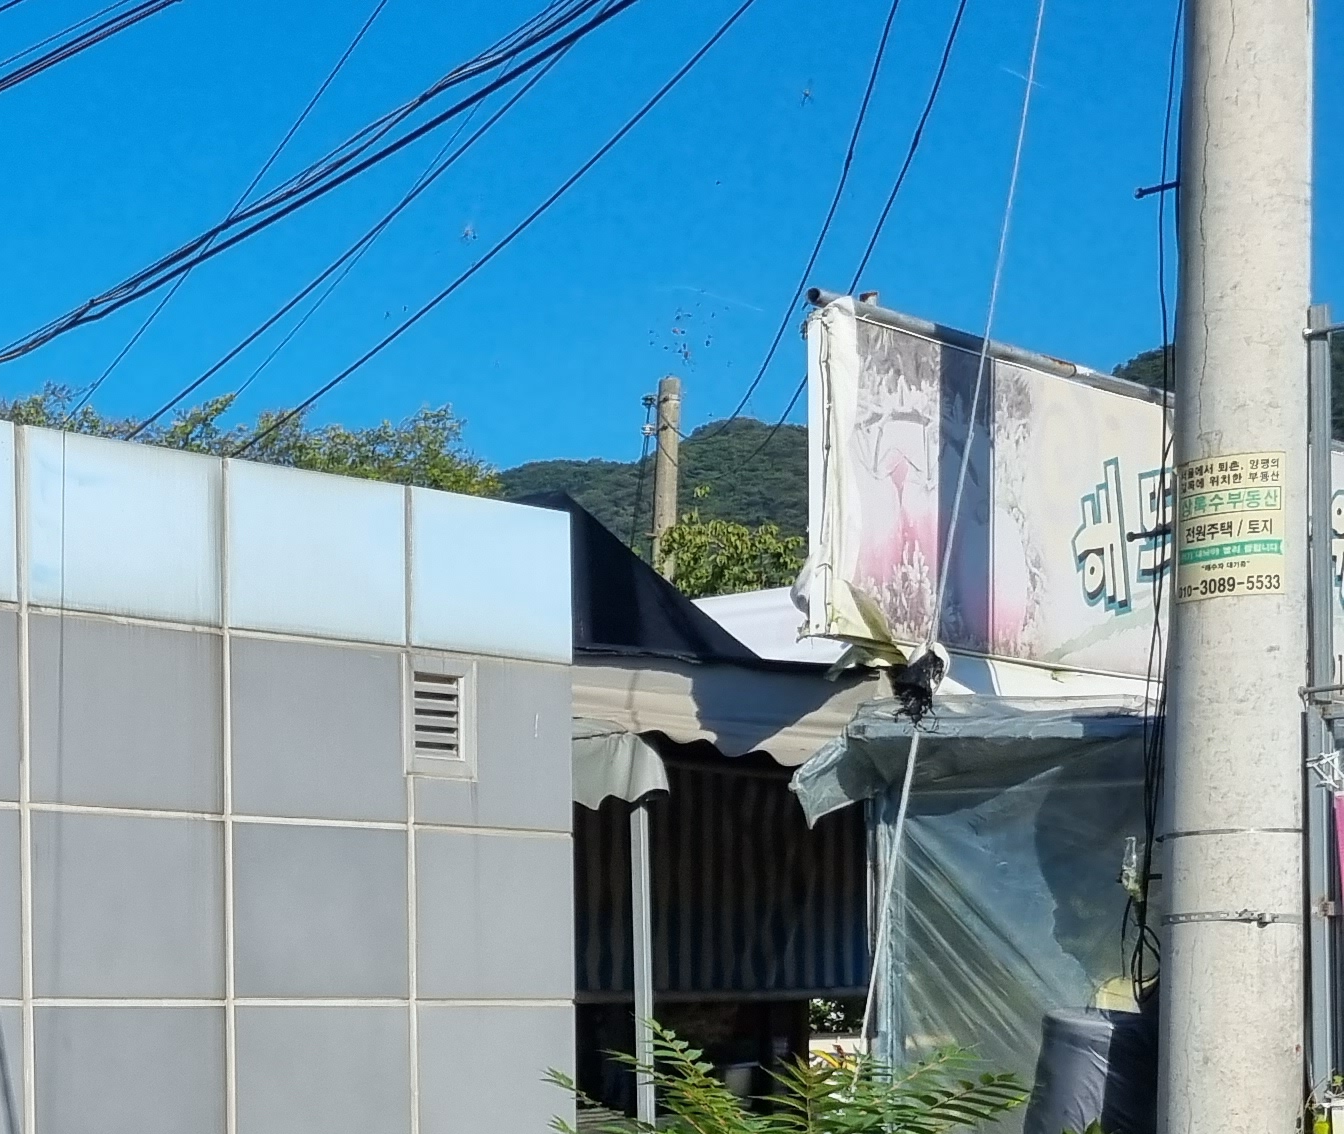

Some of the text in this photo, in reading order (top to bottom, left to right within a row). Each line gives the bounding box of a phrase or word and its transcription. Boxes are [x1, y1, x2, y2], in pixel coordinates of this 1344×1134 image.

[1209, 472, 1243, 487] 위치한
[1248, 471, 1280, 483] 부동산
[1185, 518, 1273, 544] 전원주택 / 토지
[1179, 574, 1281, 599] 010-3089-5533
